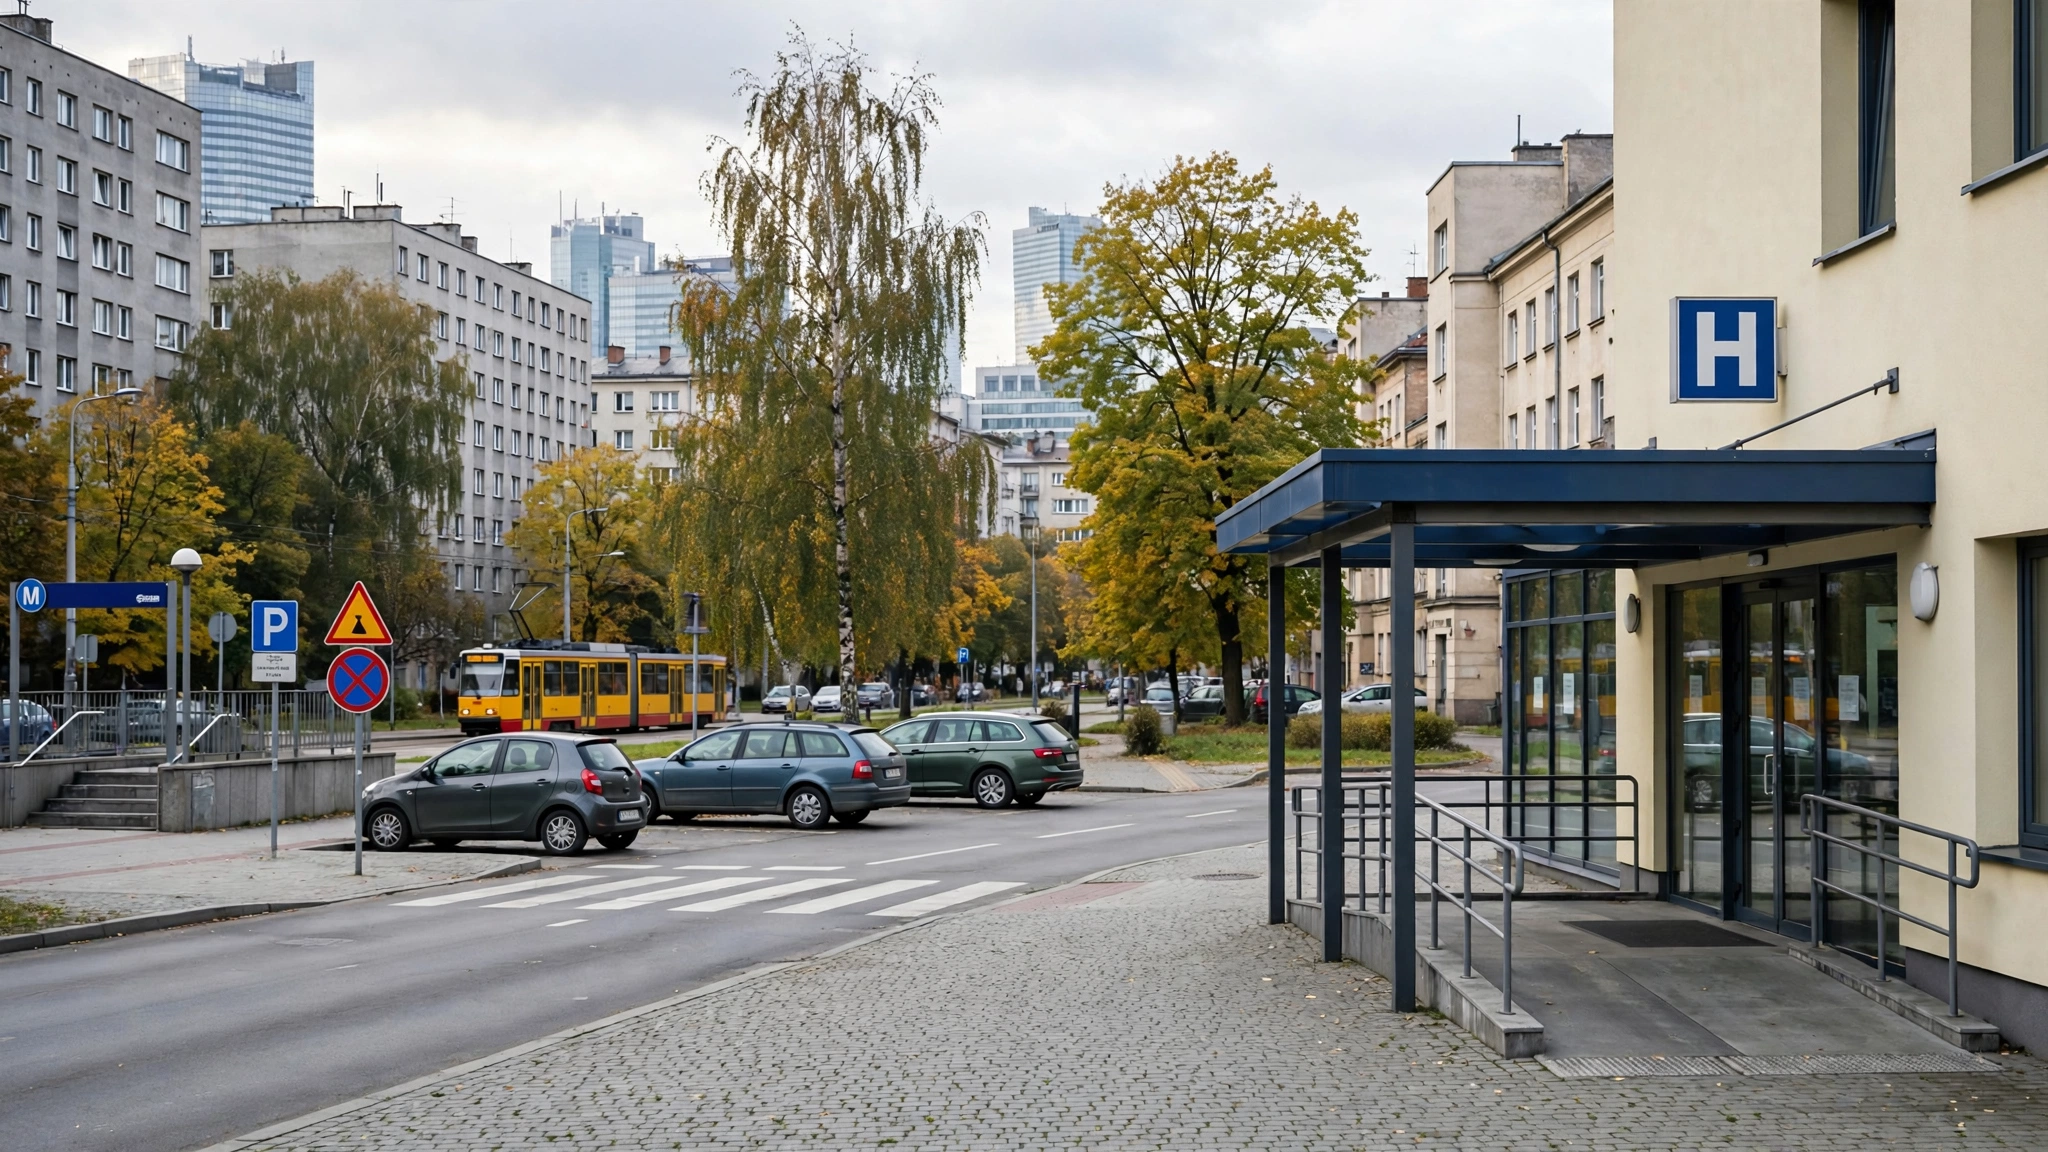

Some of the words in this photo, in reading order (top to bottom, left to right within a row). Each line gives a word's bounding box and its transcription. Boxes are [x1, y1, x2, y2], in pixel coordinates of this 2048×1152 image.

[1697, 311, 1756, 386] H
[23, 586, 39, 605] M
[264, 607, 288, 646] P
